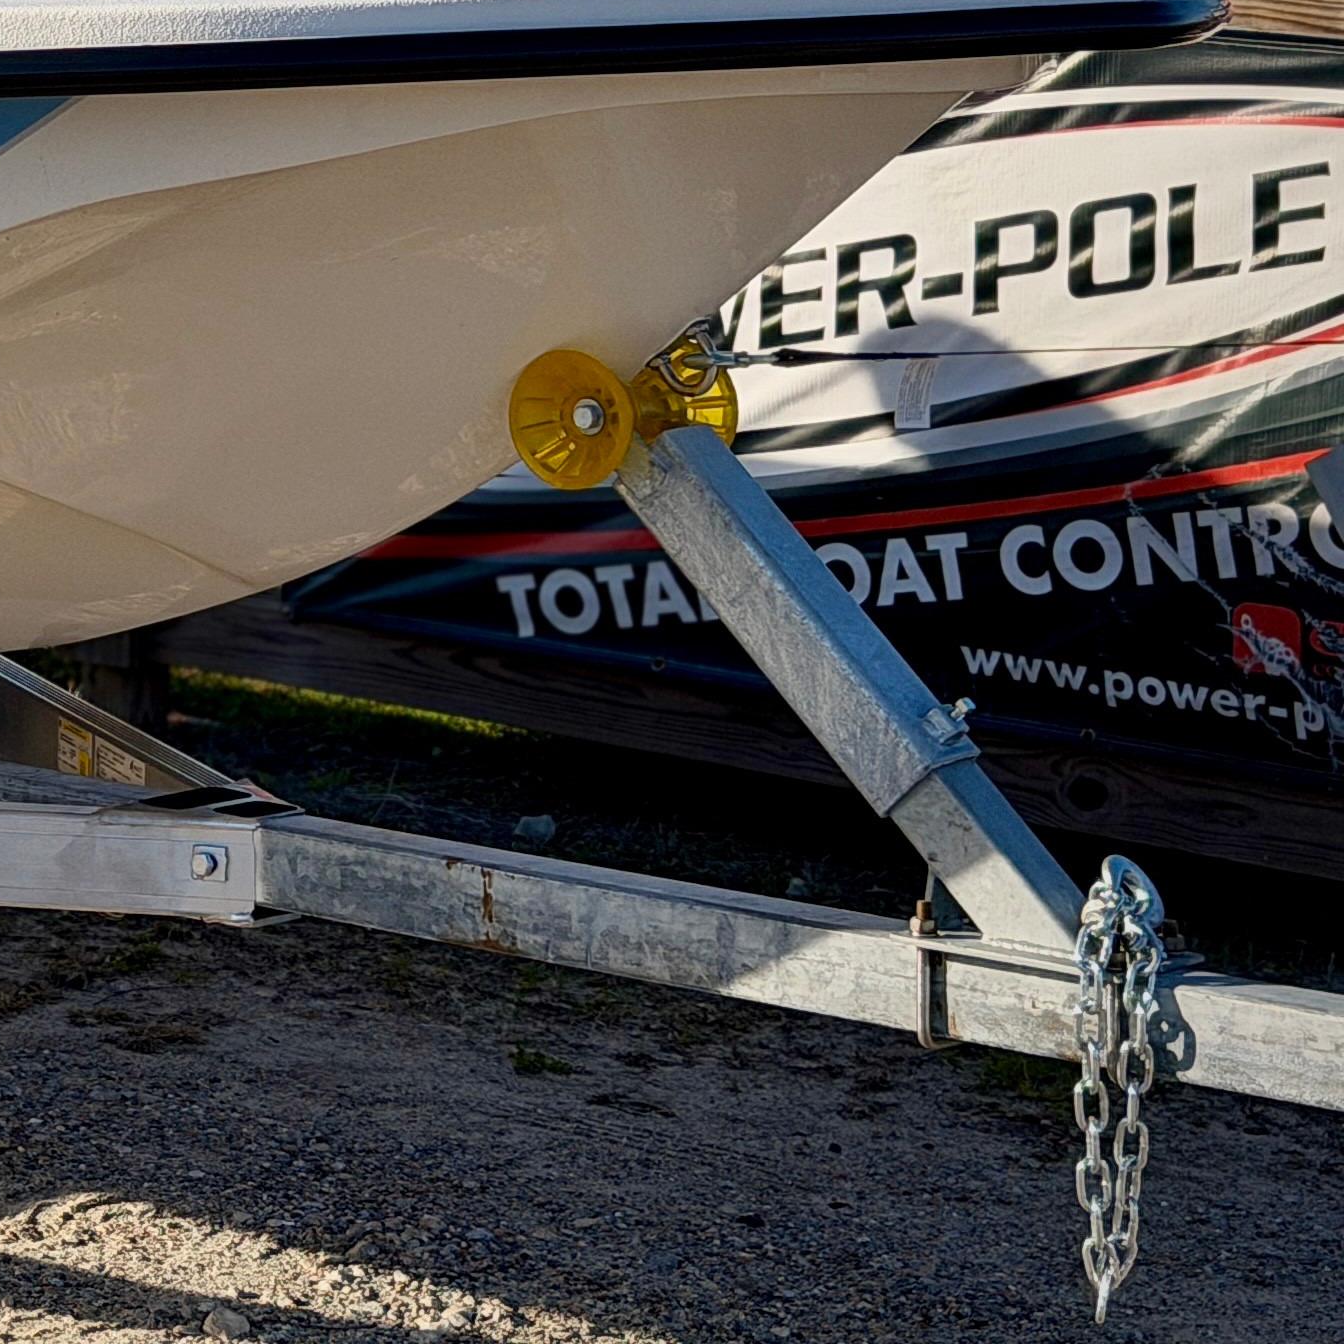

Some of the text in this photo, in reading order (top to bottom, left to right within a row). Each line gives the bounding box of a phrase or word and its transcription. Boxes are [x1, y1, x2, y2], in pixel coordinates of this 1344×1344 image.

[712, 161, 1330, 352] ER-POLE
[496, 560, 720, 639] TOTA
[820, 532, 968, 608] OAT
